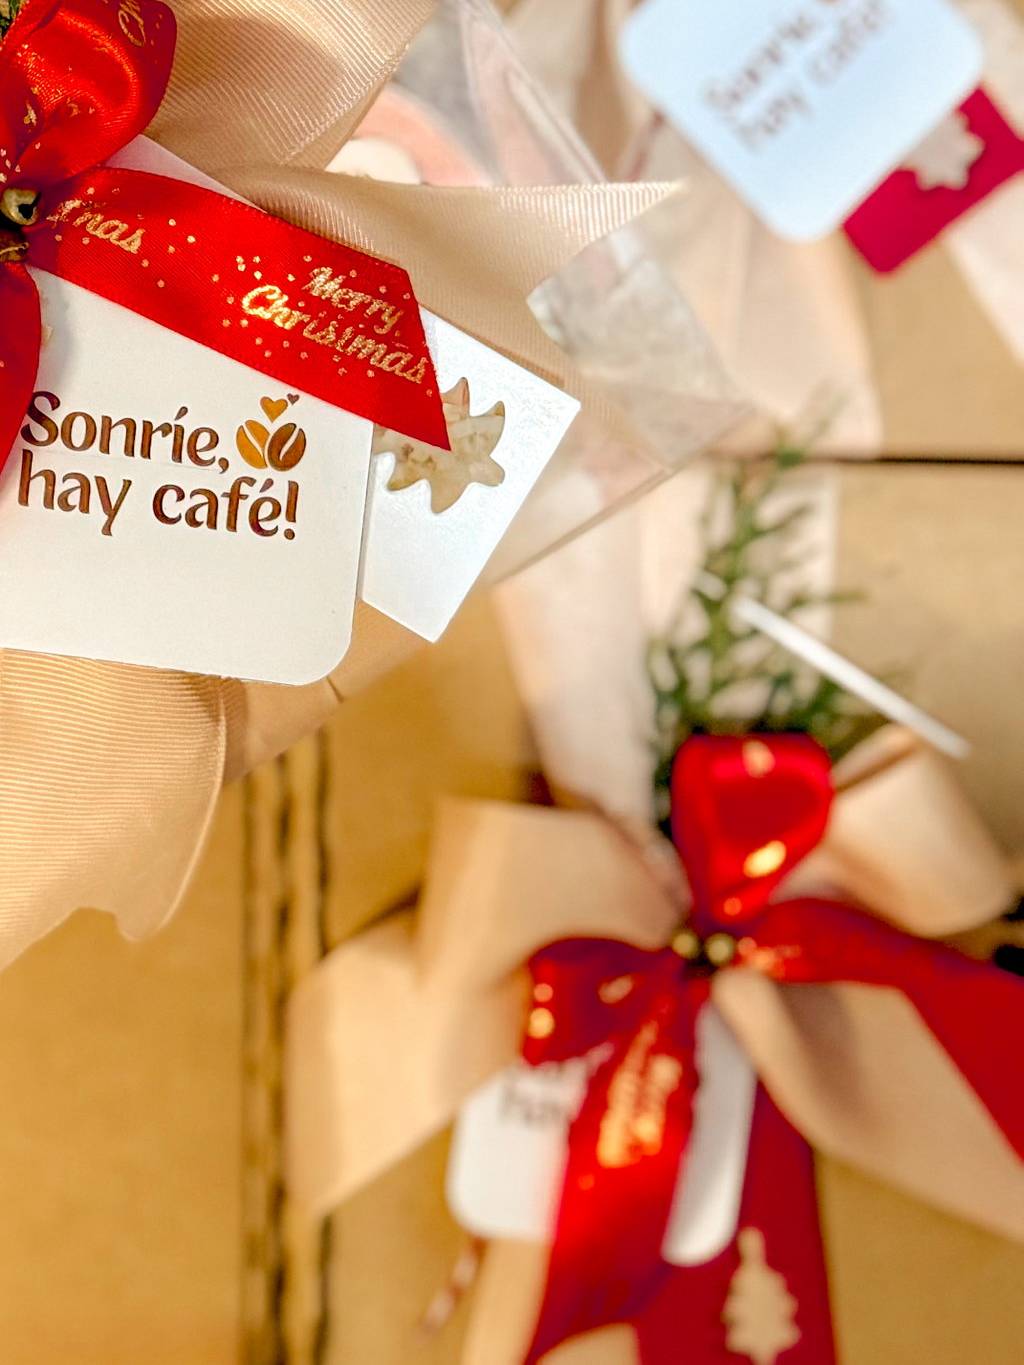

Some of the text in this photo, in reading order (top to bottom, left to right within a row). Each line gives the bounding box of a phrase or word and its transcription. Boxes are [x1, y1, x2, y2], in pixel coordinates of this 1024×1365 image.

[242, 285, 426, 383] Christmas
[302, 266, 403, 334] Merry
[20, 391, 229, 473] Sonríe,
[18, 449, 299, 540] hay café!
